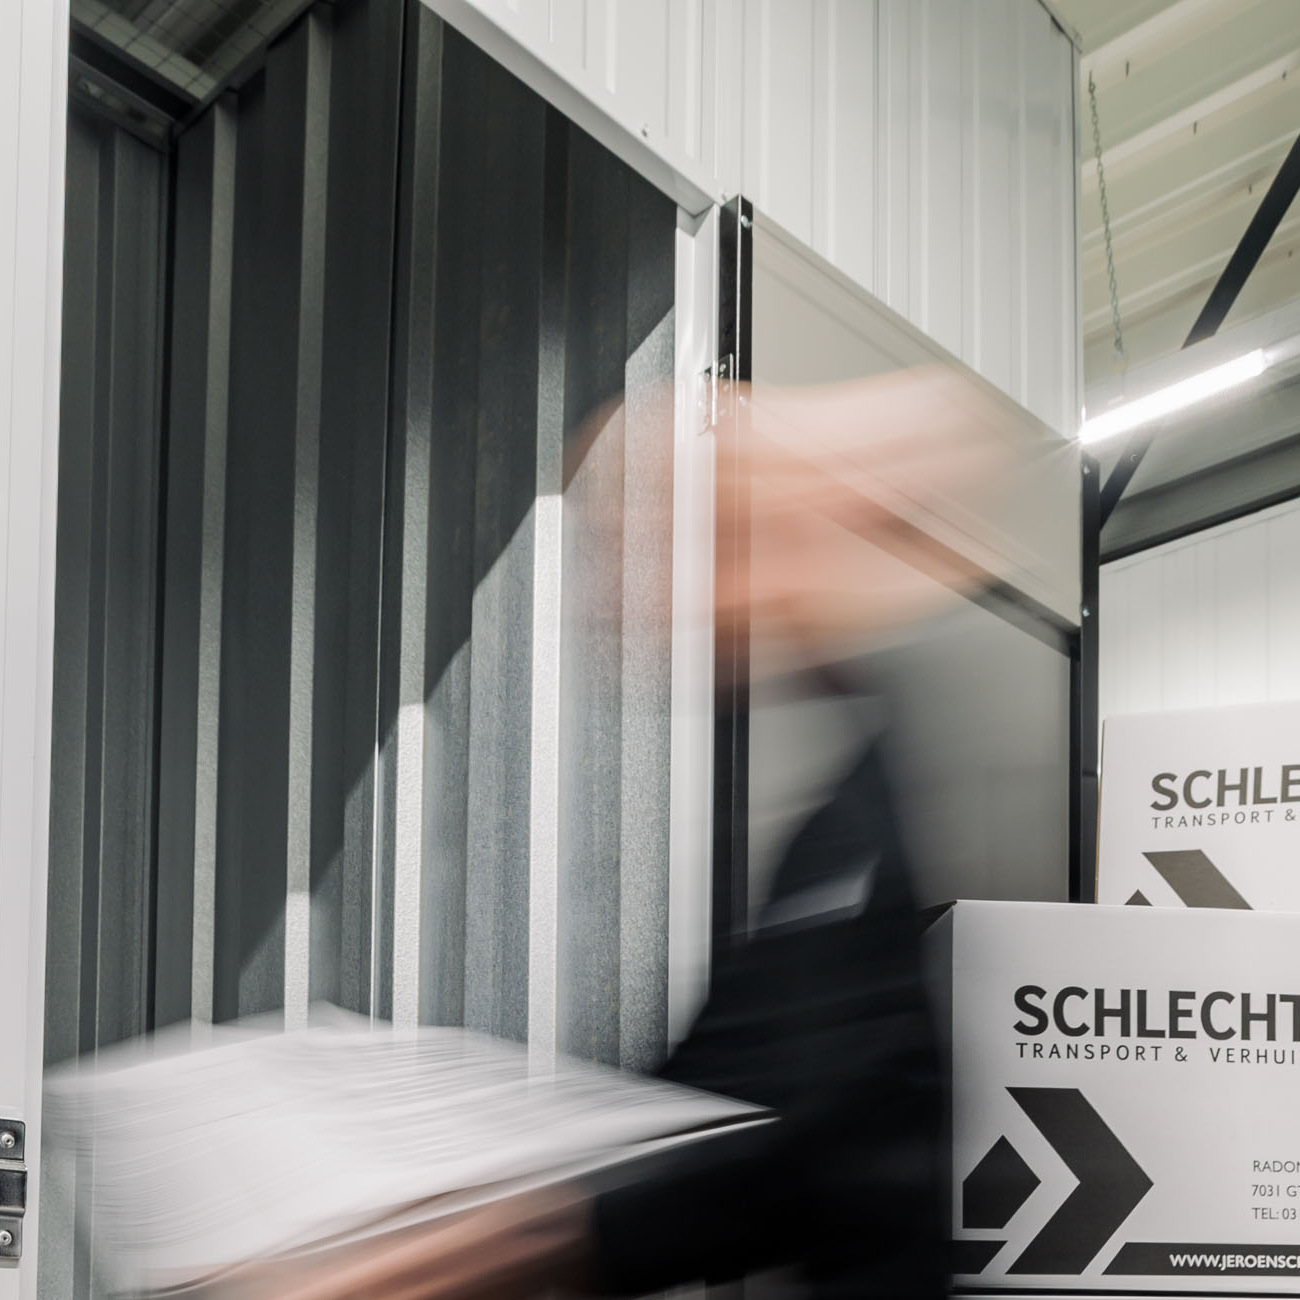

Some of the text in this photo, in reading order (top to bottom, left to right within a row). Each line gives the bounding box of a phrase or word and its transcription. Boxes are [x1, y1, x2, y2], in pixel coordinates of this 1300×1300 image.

[1150, 810, 1272, 829] TRANSPORT
[1283, 809, 1295, 821] &
[1015, 1042, 1161, 1061] TRANSPORT
[1175, 1046, 1187, 1062] &
[1252, 1184, 1279, 1197] 7031
